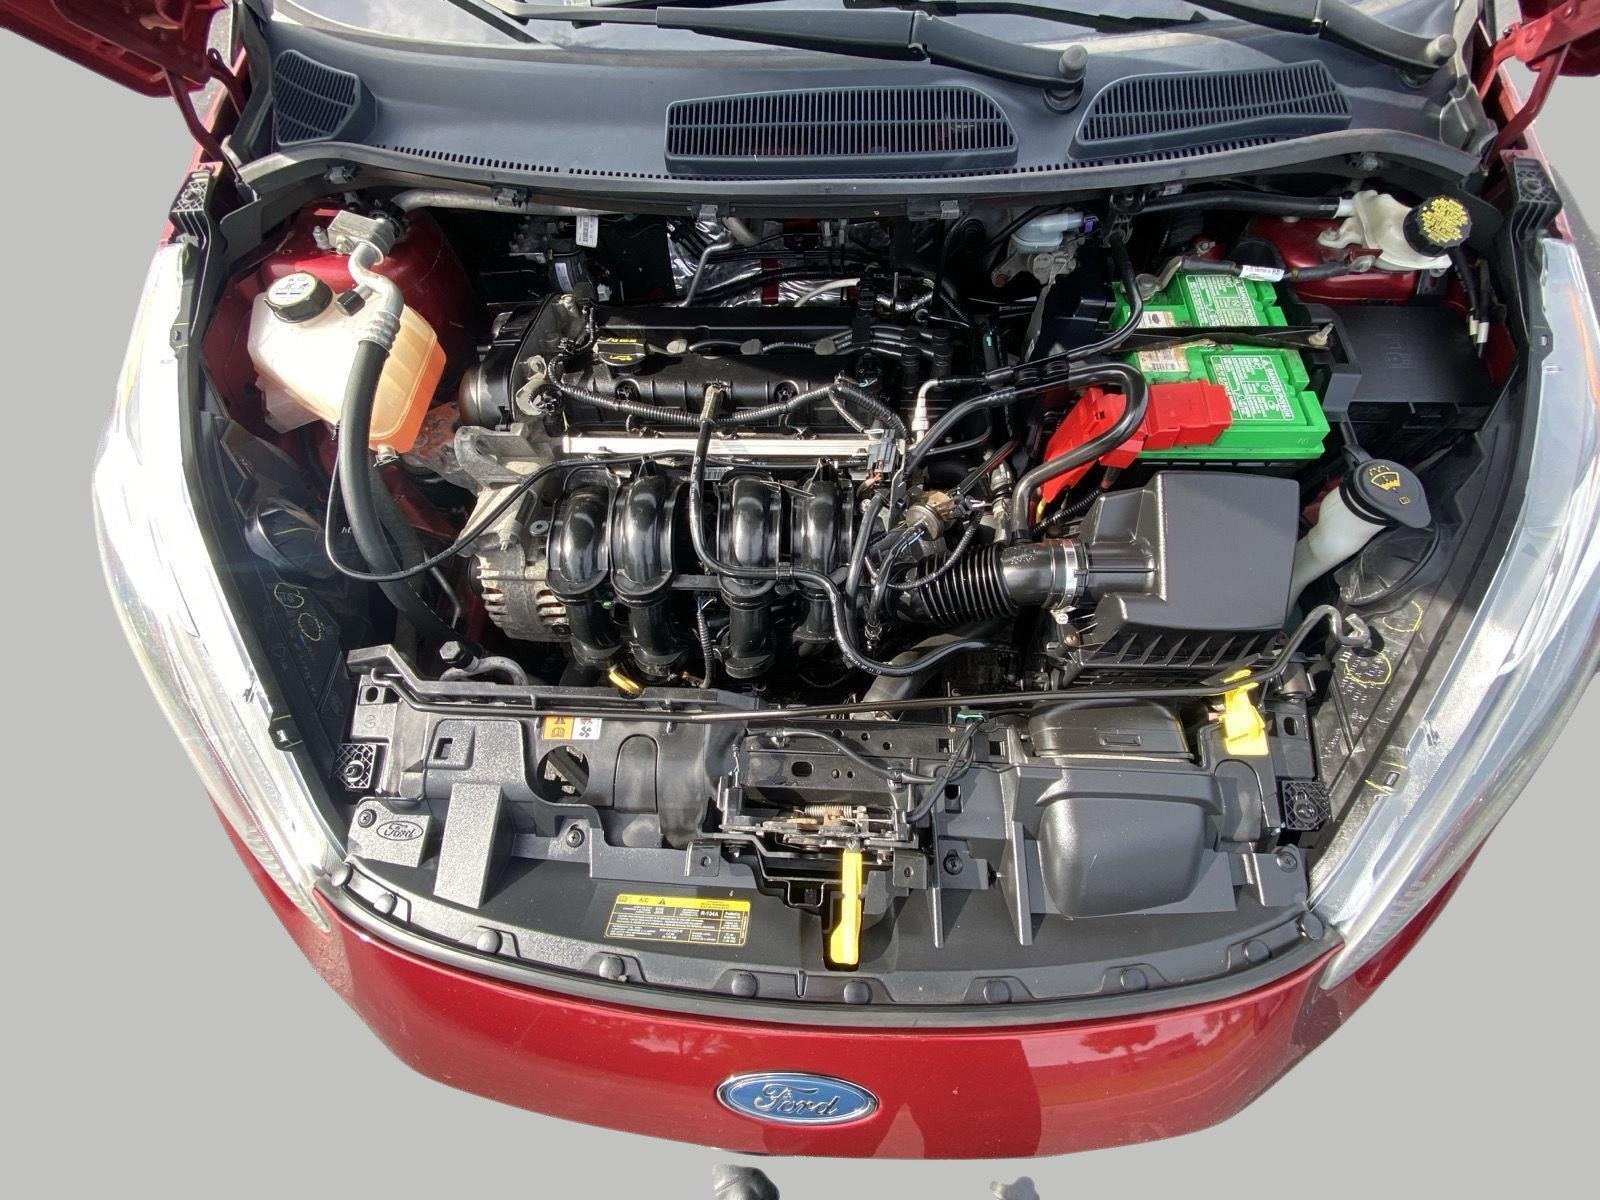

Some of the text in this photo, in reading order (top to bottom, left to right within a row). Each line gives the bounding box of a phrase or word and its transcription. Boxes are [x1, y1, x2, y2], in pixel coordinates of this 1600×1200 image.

[1266, 368, 1292, 418] DANGER/POISON
[384, 822, 416, 838] Ford
[754, 1083, 840, 1115] Ford
